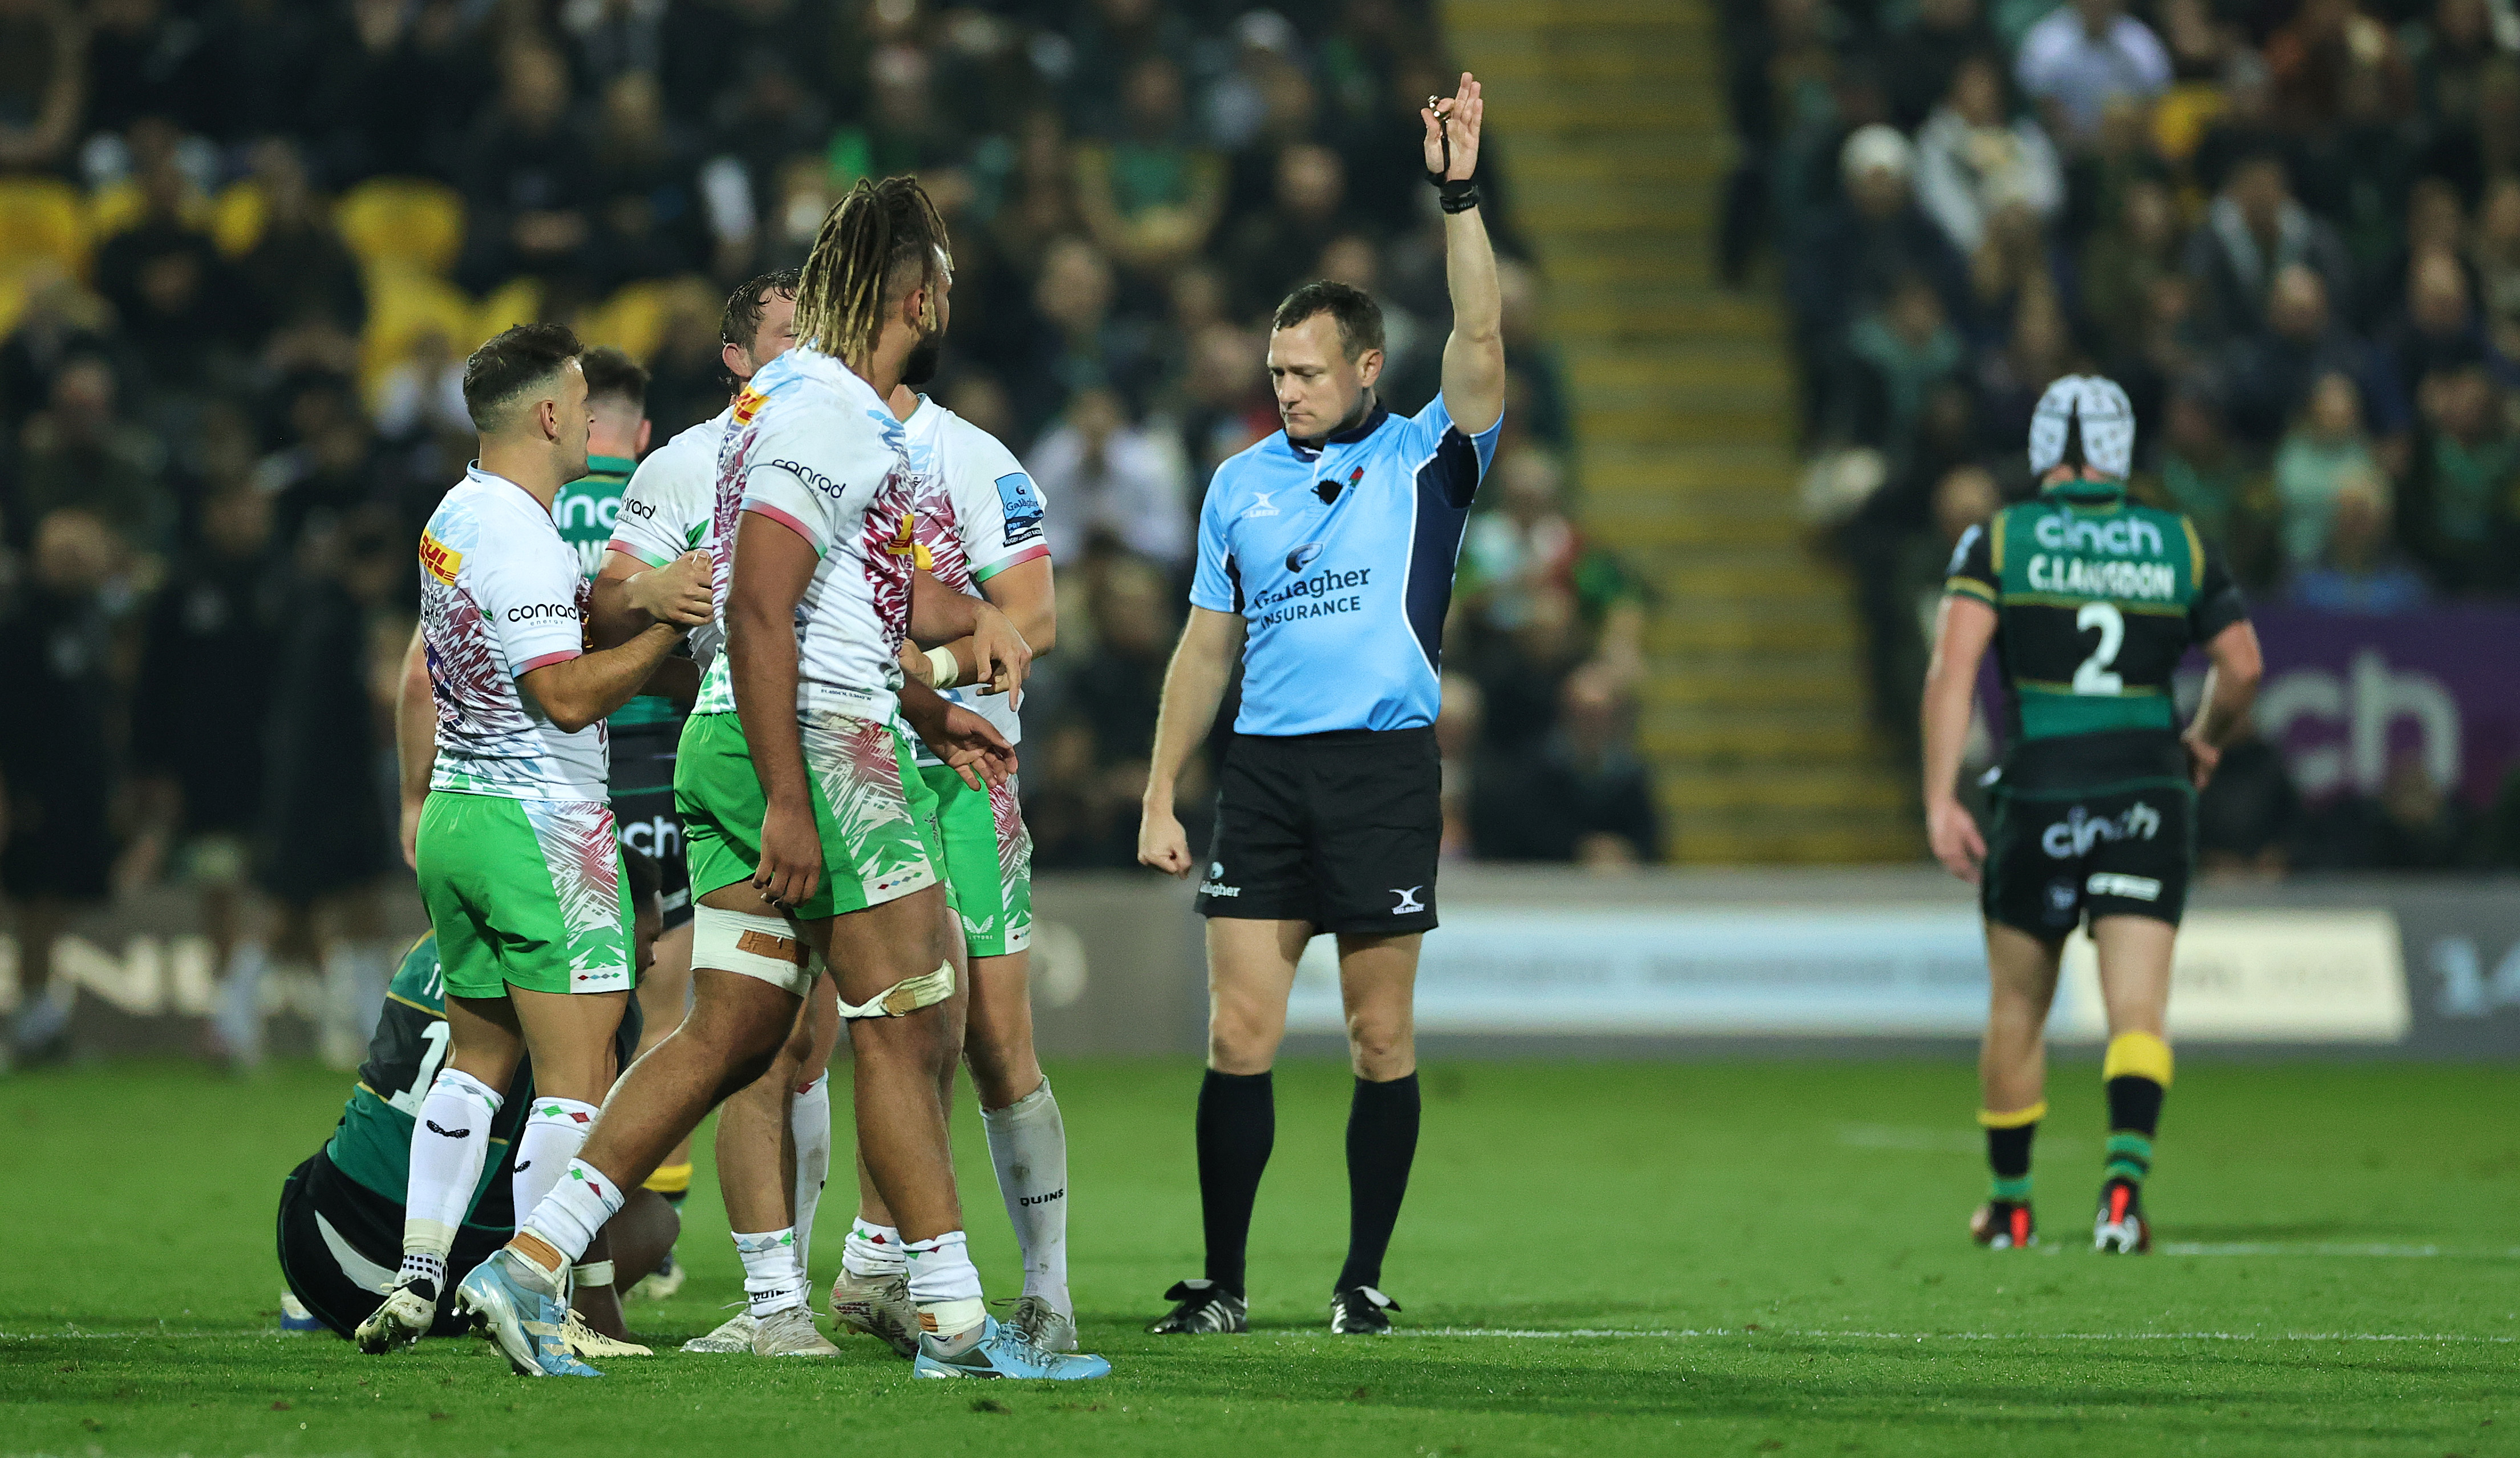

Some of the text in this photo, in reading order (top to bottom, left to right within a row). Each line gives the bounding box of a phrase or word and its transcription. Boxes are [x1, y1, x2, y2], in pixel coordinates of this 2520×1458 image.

[2034, 505, 2164, 557] cinch
[508, 604, 577, 622] conrad
[1261, 596, 1361, 630] INSURANCE
[2072, 601, 2125, 696] 2
[1020, 1188, 1064, 1207] QUINS
[753, 1290, 793, 1302] QUIN
